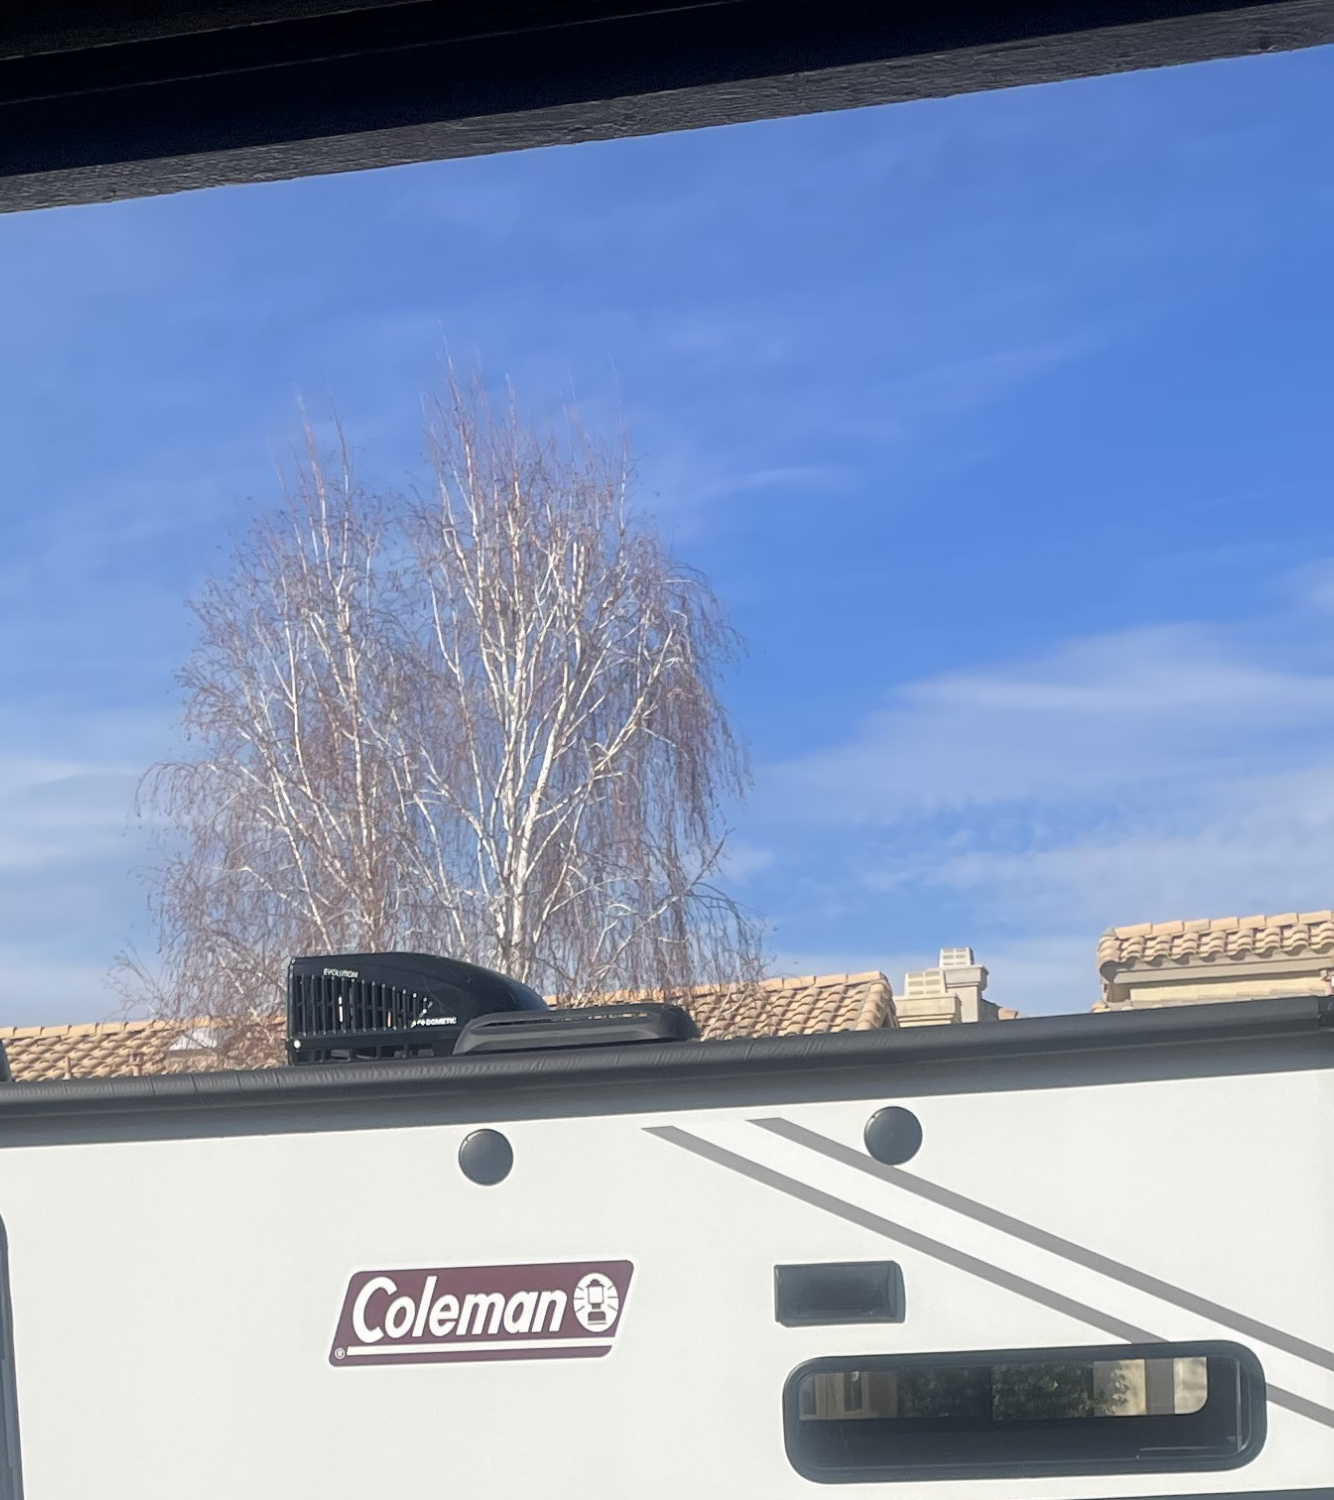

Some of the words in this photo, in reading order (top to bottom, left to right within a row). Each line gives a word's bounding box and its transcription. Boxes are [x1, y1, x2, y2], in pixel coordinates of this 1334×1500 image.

[323, 967, 359, 978] EVOLUTION
[426, 1016, 457, 1026] DOMETIC
[352, 1274, 567, 1344] Coleman
